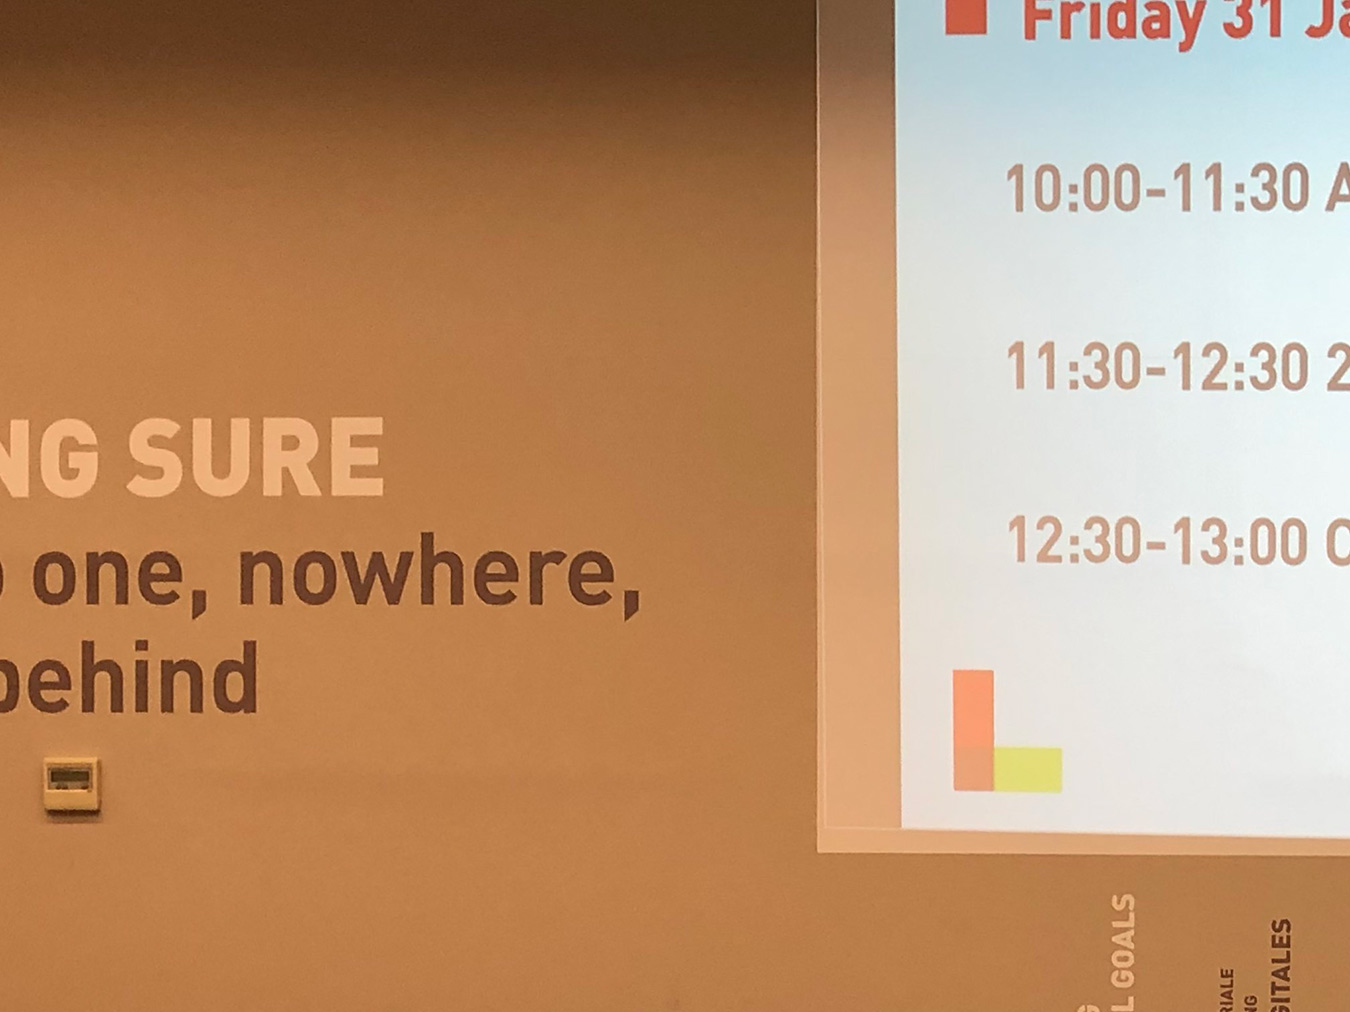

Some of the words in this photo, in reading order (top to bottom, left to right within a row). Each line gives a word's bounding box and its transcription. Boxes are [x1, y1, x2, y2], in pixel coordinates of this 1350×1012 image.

[1024, 0, 1208, 53] Friday
[1223, 0, 1281, 39] 31
[1006, 161, 1310, 213] 10:00-11:30
[1007, 340, 1309, 392] 11:30-12:30
[126, 416, 384, 498] SURE
[1008, 514, 1308, 567] 12:30-13:00
[32, 551, 207, 620] one,
[240, 531, 640, 622] nowhere,
[1111, 893, 1136, 989] GOALS
